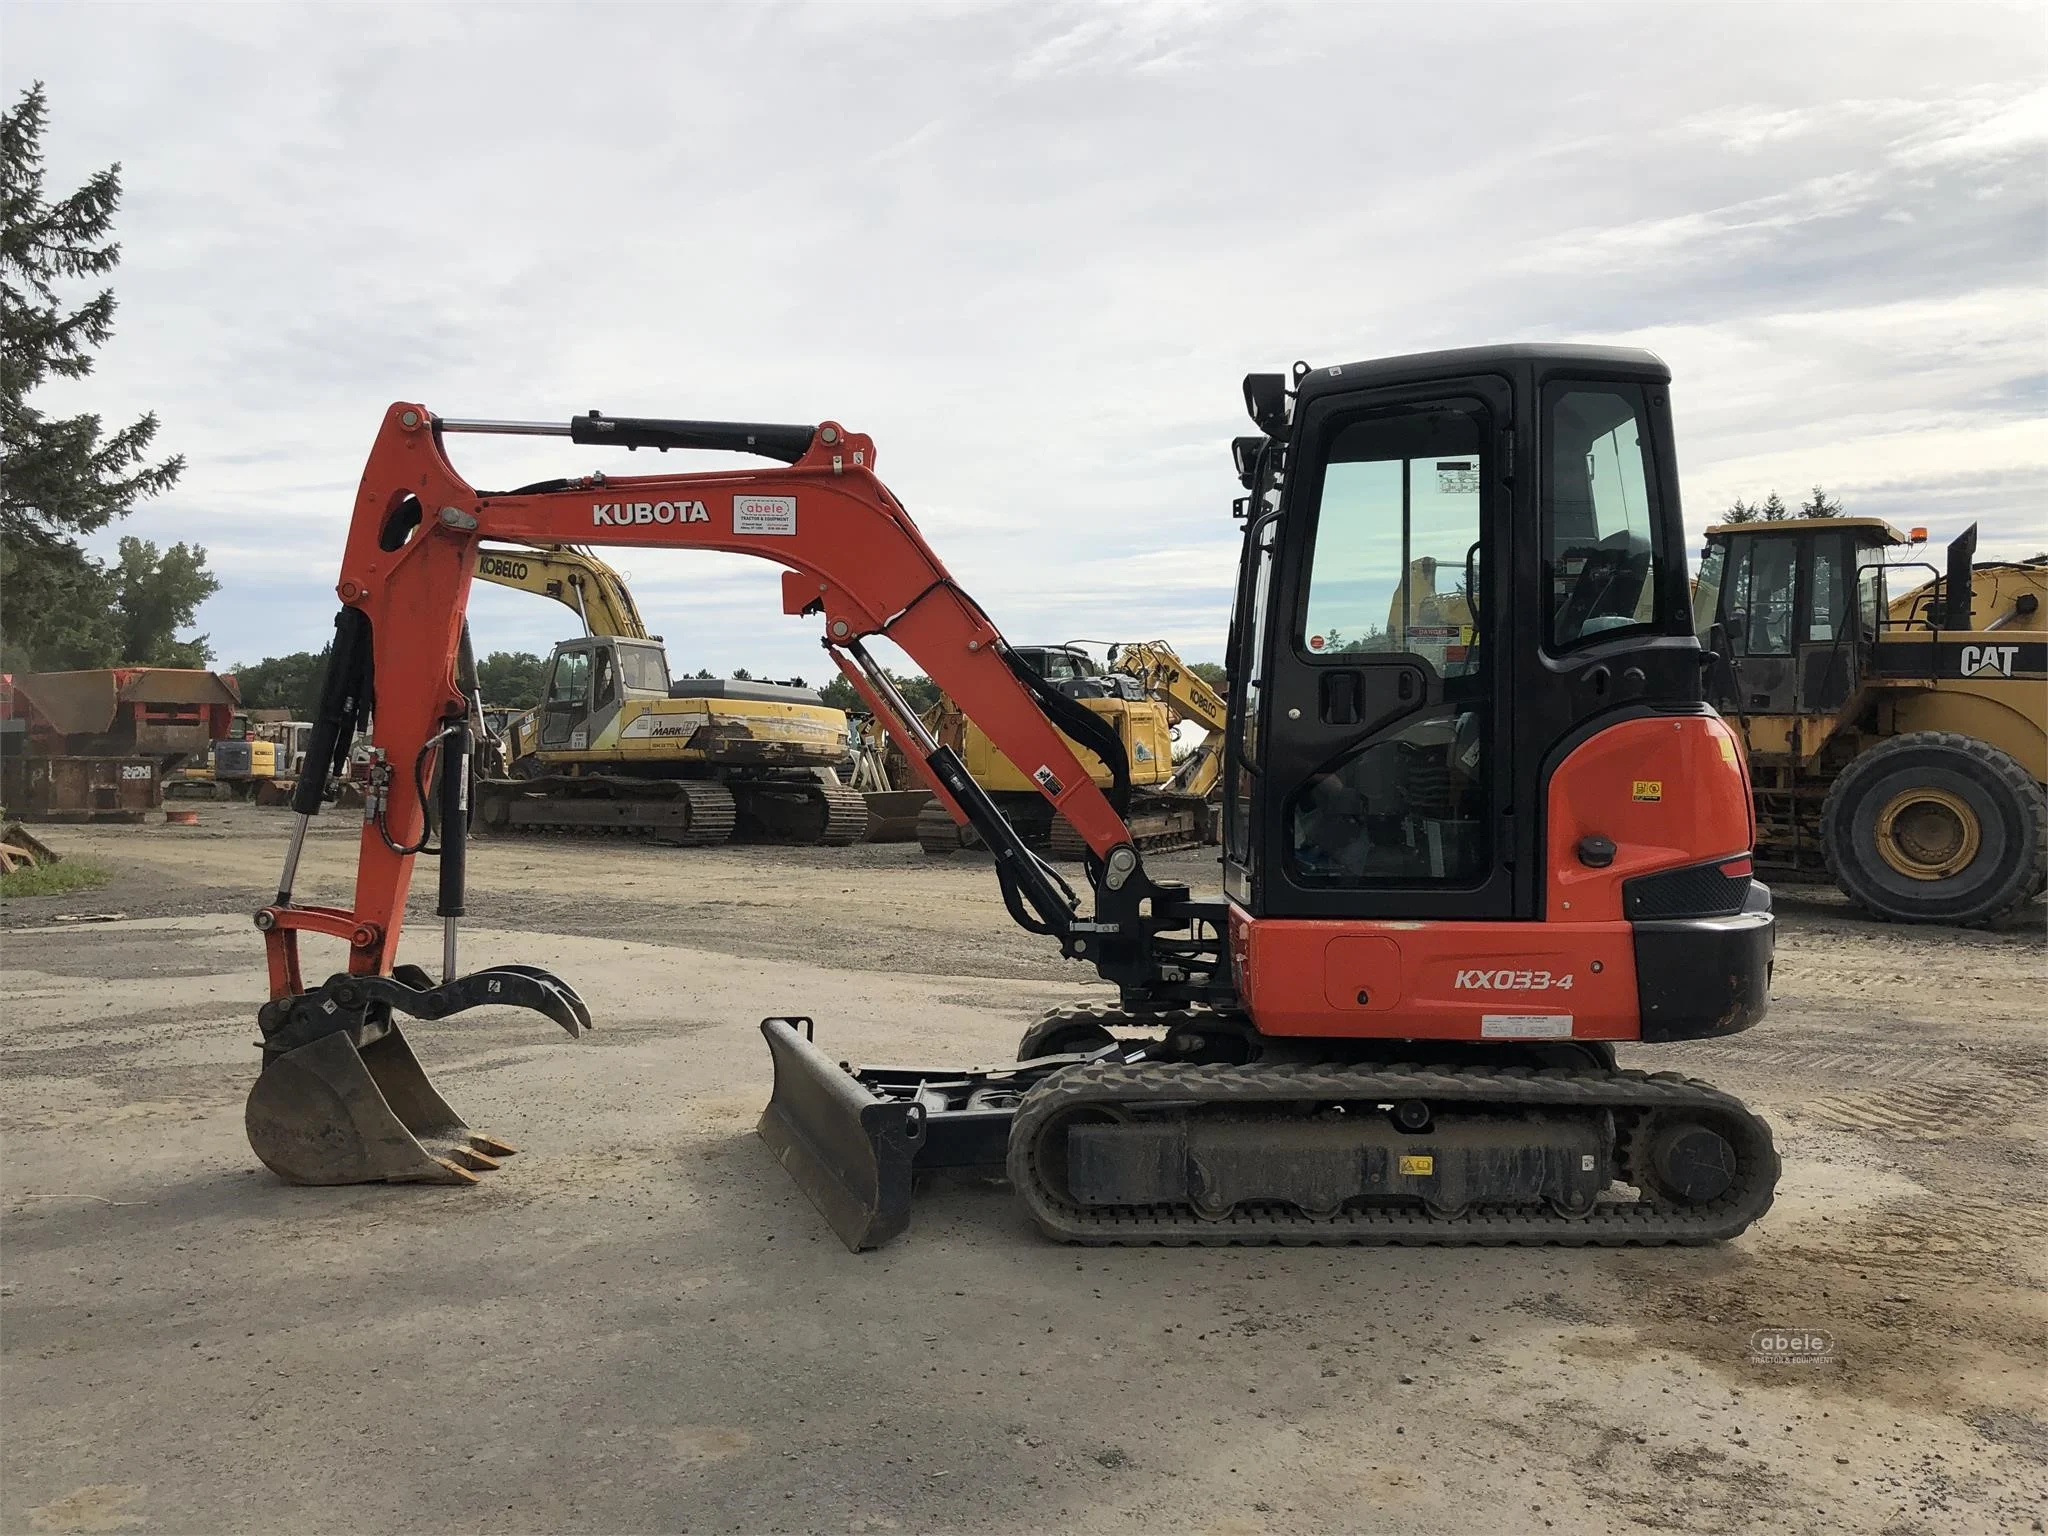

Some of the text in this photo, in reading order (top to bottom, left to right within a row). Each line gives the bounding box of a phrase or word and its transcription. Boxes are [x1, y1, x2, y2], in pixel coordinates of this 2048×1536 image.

[593, 501, 709, 525] KUBOTA
[747, 503, 783, 513] abele
[479, 556, 528, 580] KOBELCO
[1960, 645, 2020, 677] CAT
[1190, 688, 1217, 718] KOBELCO
[652, 727, 682, 736] MARK
[1454, 969, 1574, 990] KX033-4
